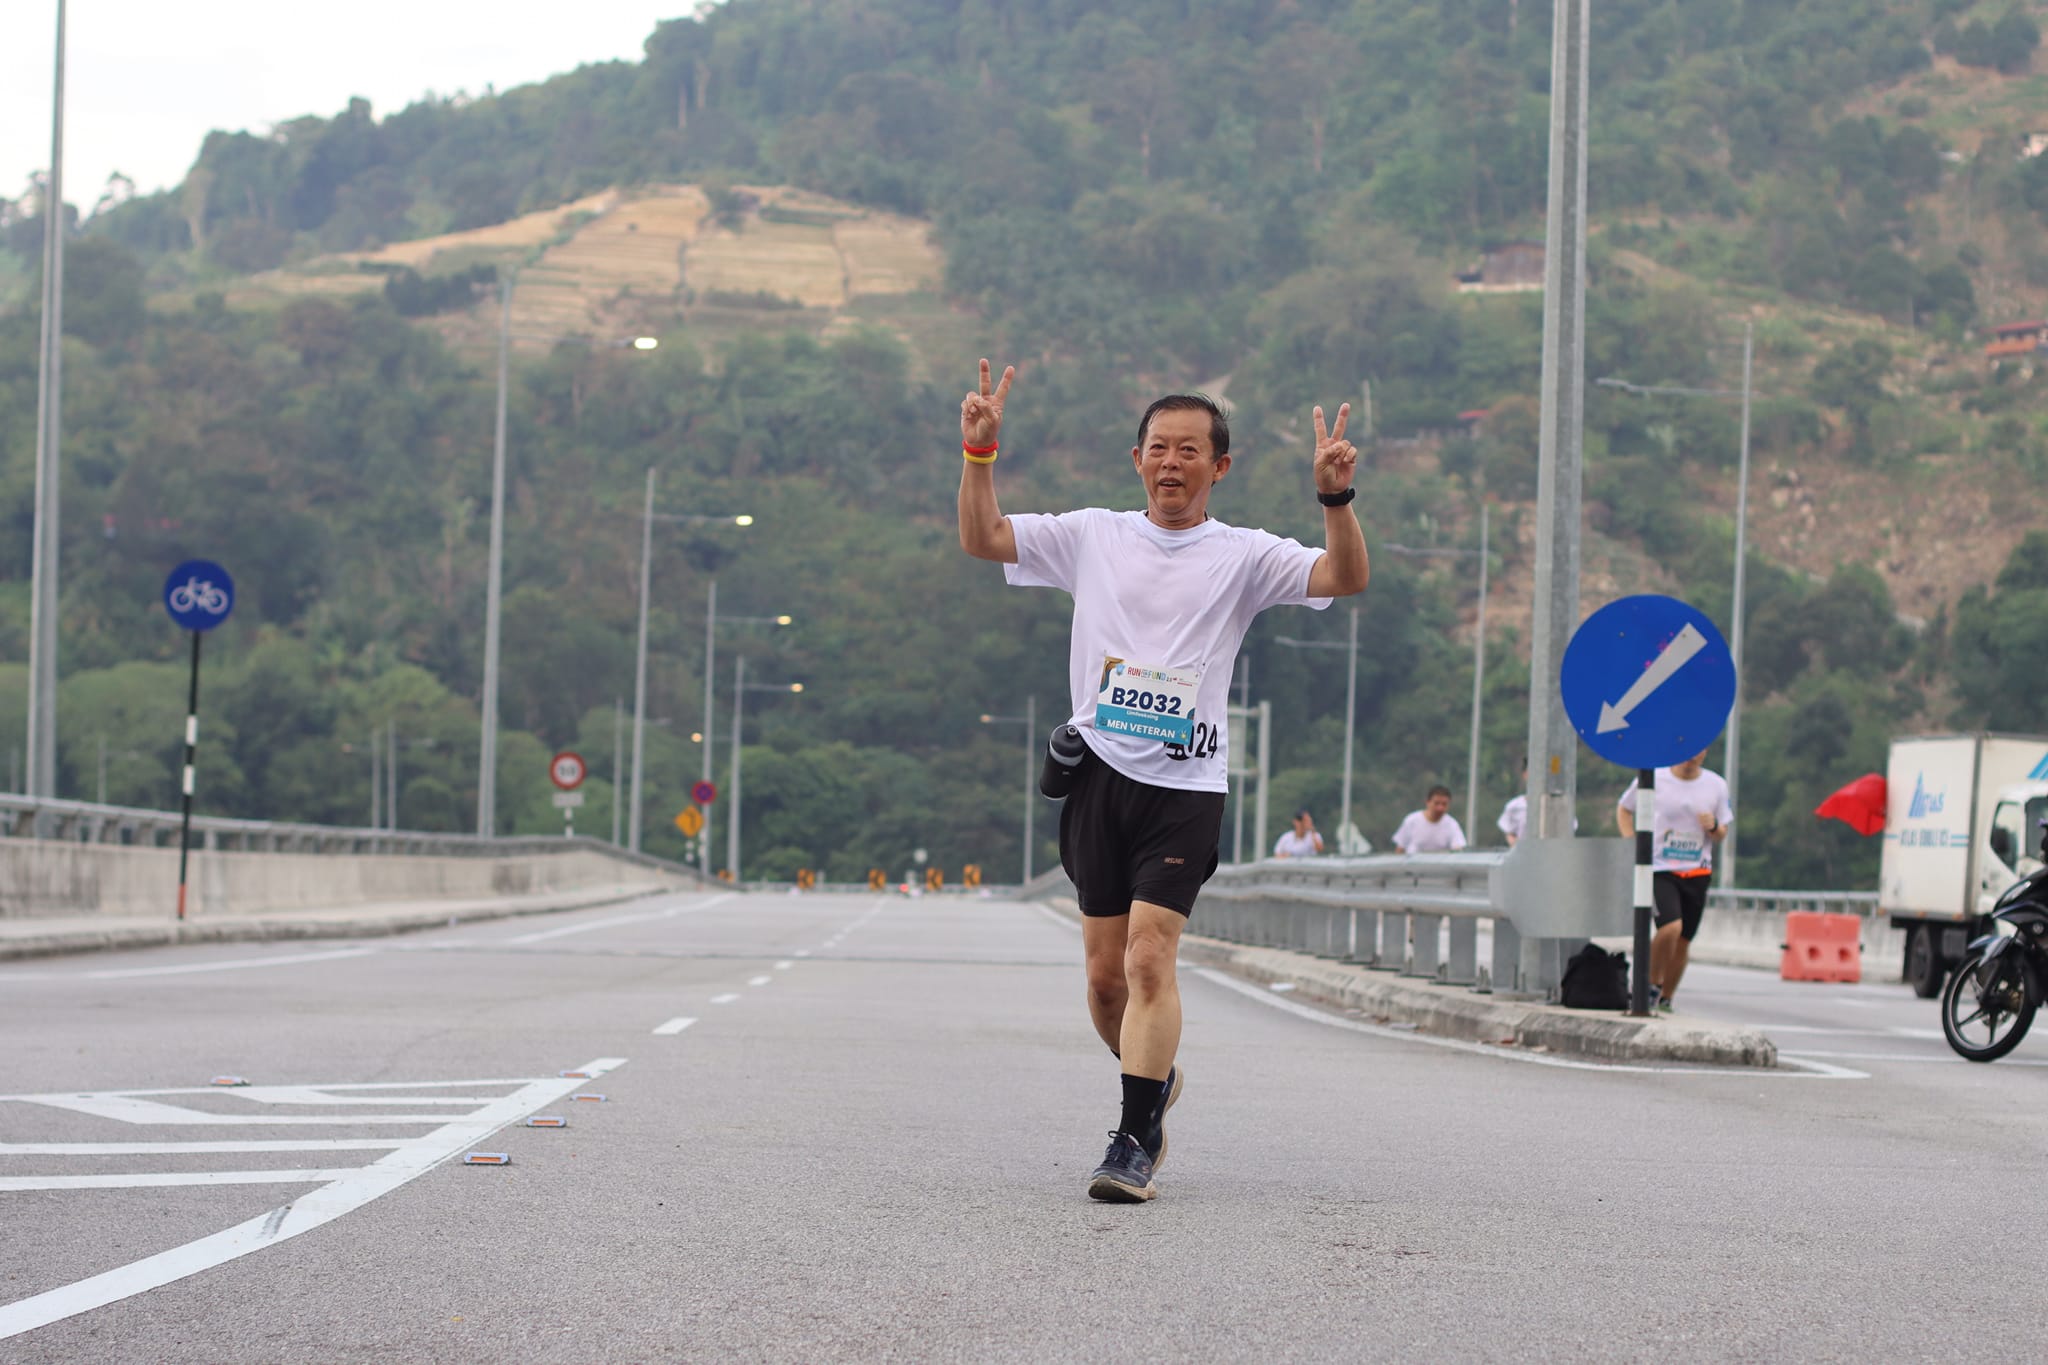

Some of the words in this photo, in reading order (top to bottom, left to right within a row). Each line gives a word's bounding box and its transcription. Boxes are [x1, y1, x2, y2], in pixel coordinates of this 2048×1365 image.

[1128, 666, 1141, 677] RUN
[1111, 686, 1182, 715] B2032
[1107, 718, 1128, 731] MEN
[1129, 723, 1175, 738] VETERAN
